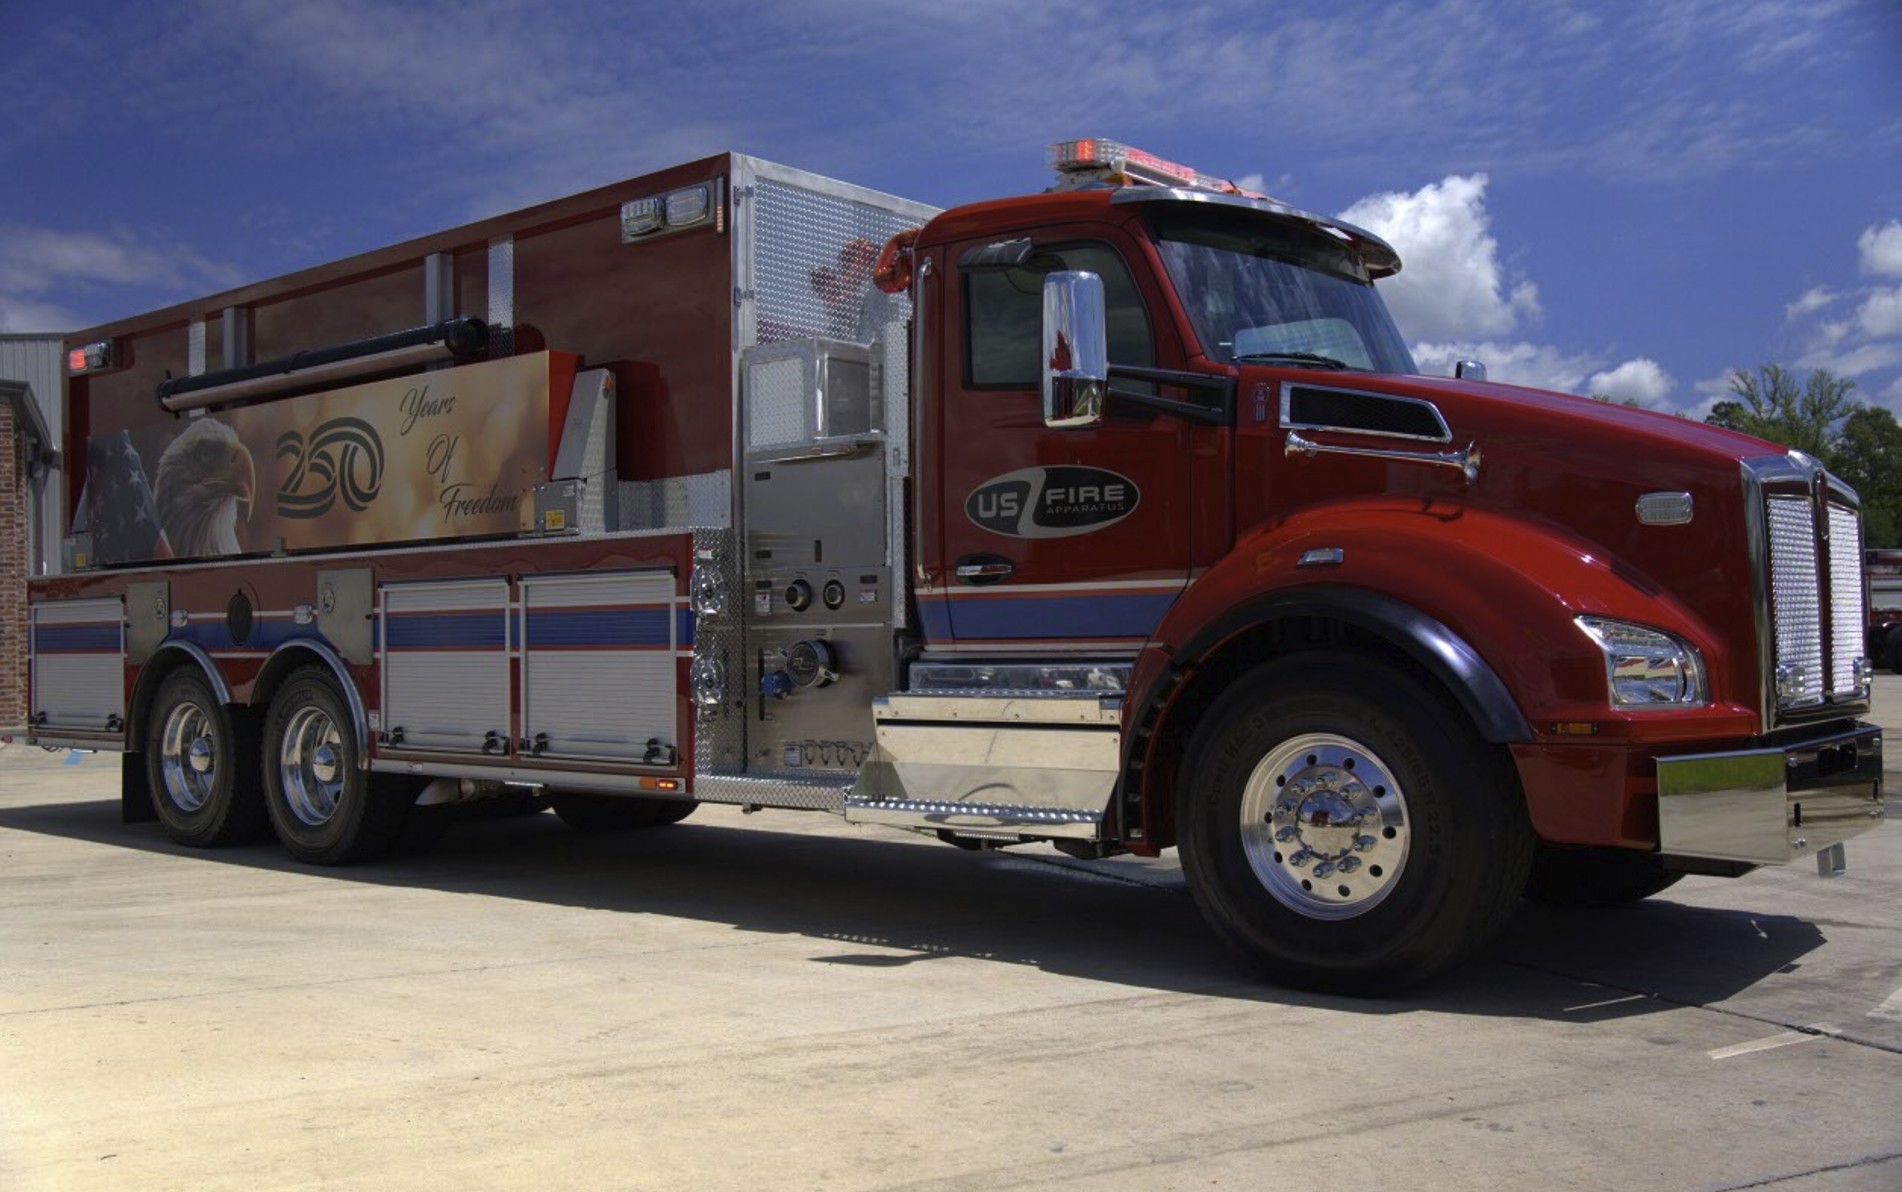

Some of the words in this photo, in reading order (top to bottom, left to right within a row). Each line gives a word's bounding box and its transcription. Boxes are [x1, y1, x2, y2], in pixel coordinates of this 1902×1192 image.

[400, 385, 456, 436] Years
[276, 416, 385, 520] 250
[426, 433, 459, 483] Of
[440, 483, 519, 524] Freedom
[978, 491, 1018, 518] US
[1046, 484, 1125, 505] FIRE
[1046, 502, 1125, 515] APPARATUS
